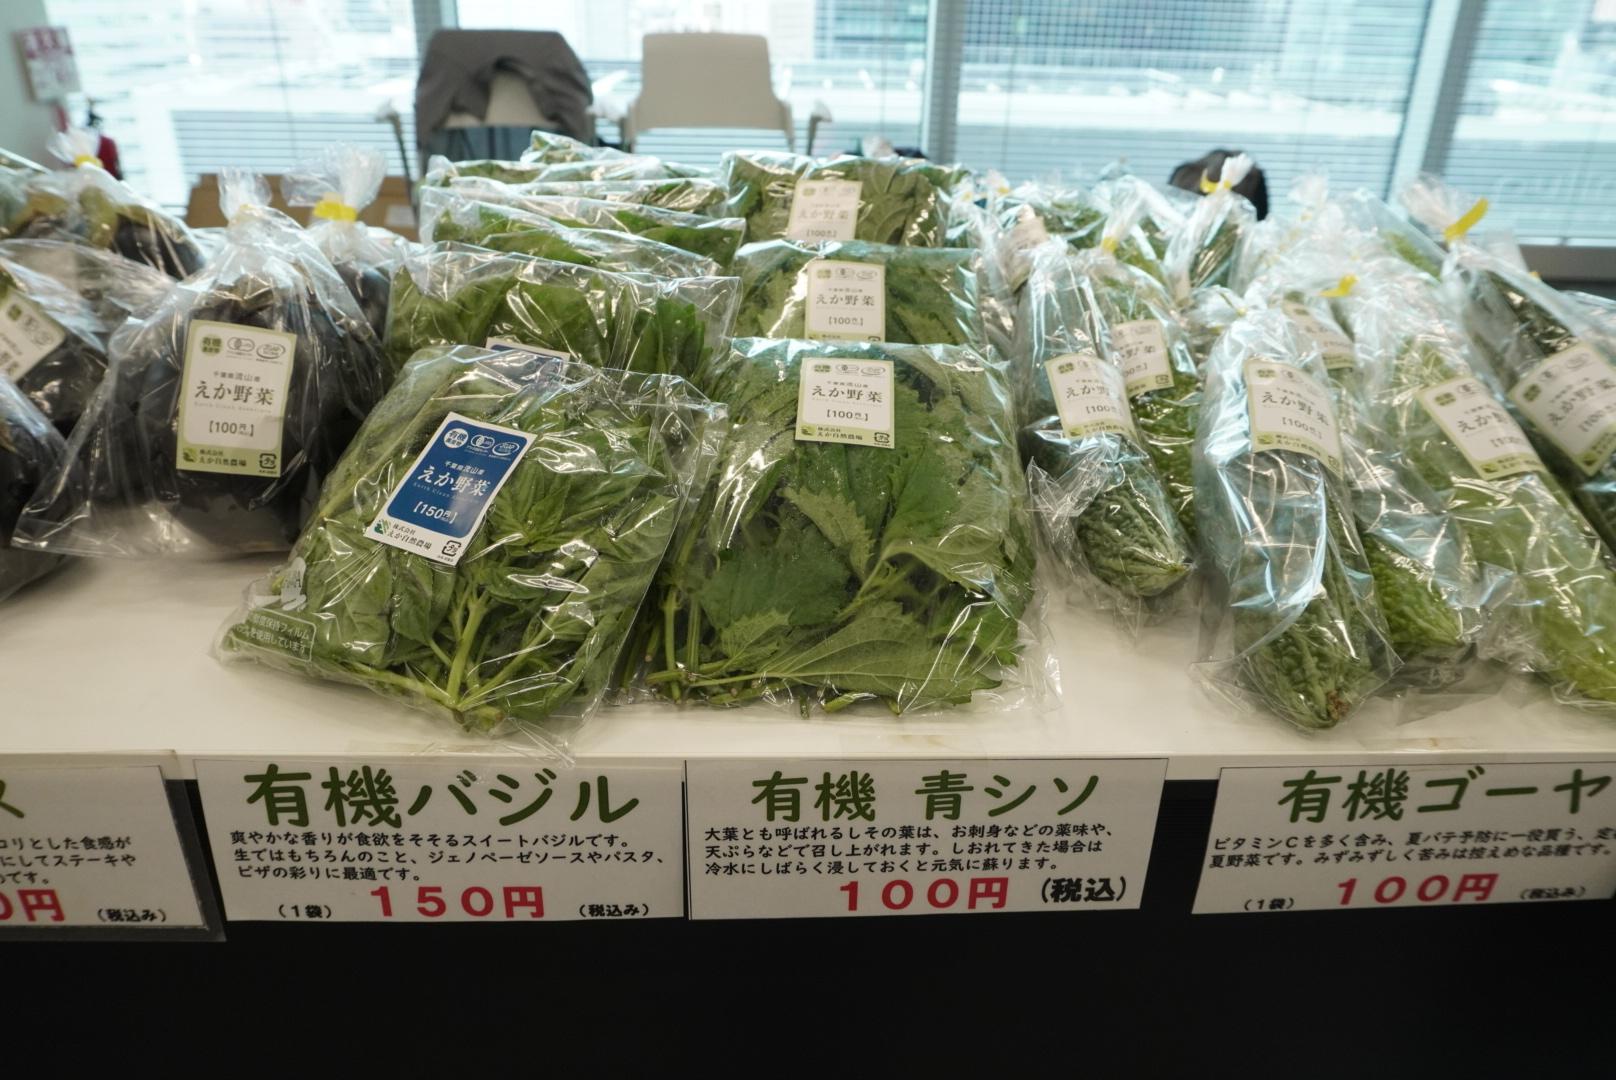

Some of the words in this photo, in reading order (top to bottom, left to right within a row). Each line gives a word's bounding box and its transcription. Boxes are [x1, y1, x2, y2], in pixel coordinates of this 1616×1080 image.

[194, 380, 276, 406] えか野菜
[812, 385, 883, 403] えか野菜
[417, 465, 491, 496] えか野菜
[243, 763, 640, 829] 有機バジル
[751, 770, 876, 822] 有機
[914, 769, 1100, 821] 青シソ
[1277, 764, 1614, 824] 有機ゴーヤ
[231, 831, 629, 847] 爽やかな香りが食欲をそそるスイートバジルです。
[705, 823, 1113, 843] 大葉とも呼ばれるしその葉は、お刺身などの薬味や、
[705, 840, 1103, 859] 天ぷらなどで召し上がれます。しおれてきた場合は
[238, 865, 420, 881] ピザの彩りに最適です。
[705, 857, 1058, 876] 冷水にしばらく浸しておくと元気に蘇ります。
[371, 885, 545, 919] 150円
[840, 876, 1009, 912] 100円
[1041, 876, 1127, 904] （税込）
[1338, 873, 1499, 906] 100円
